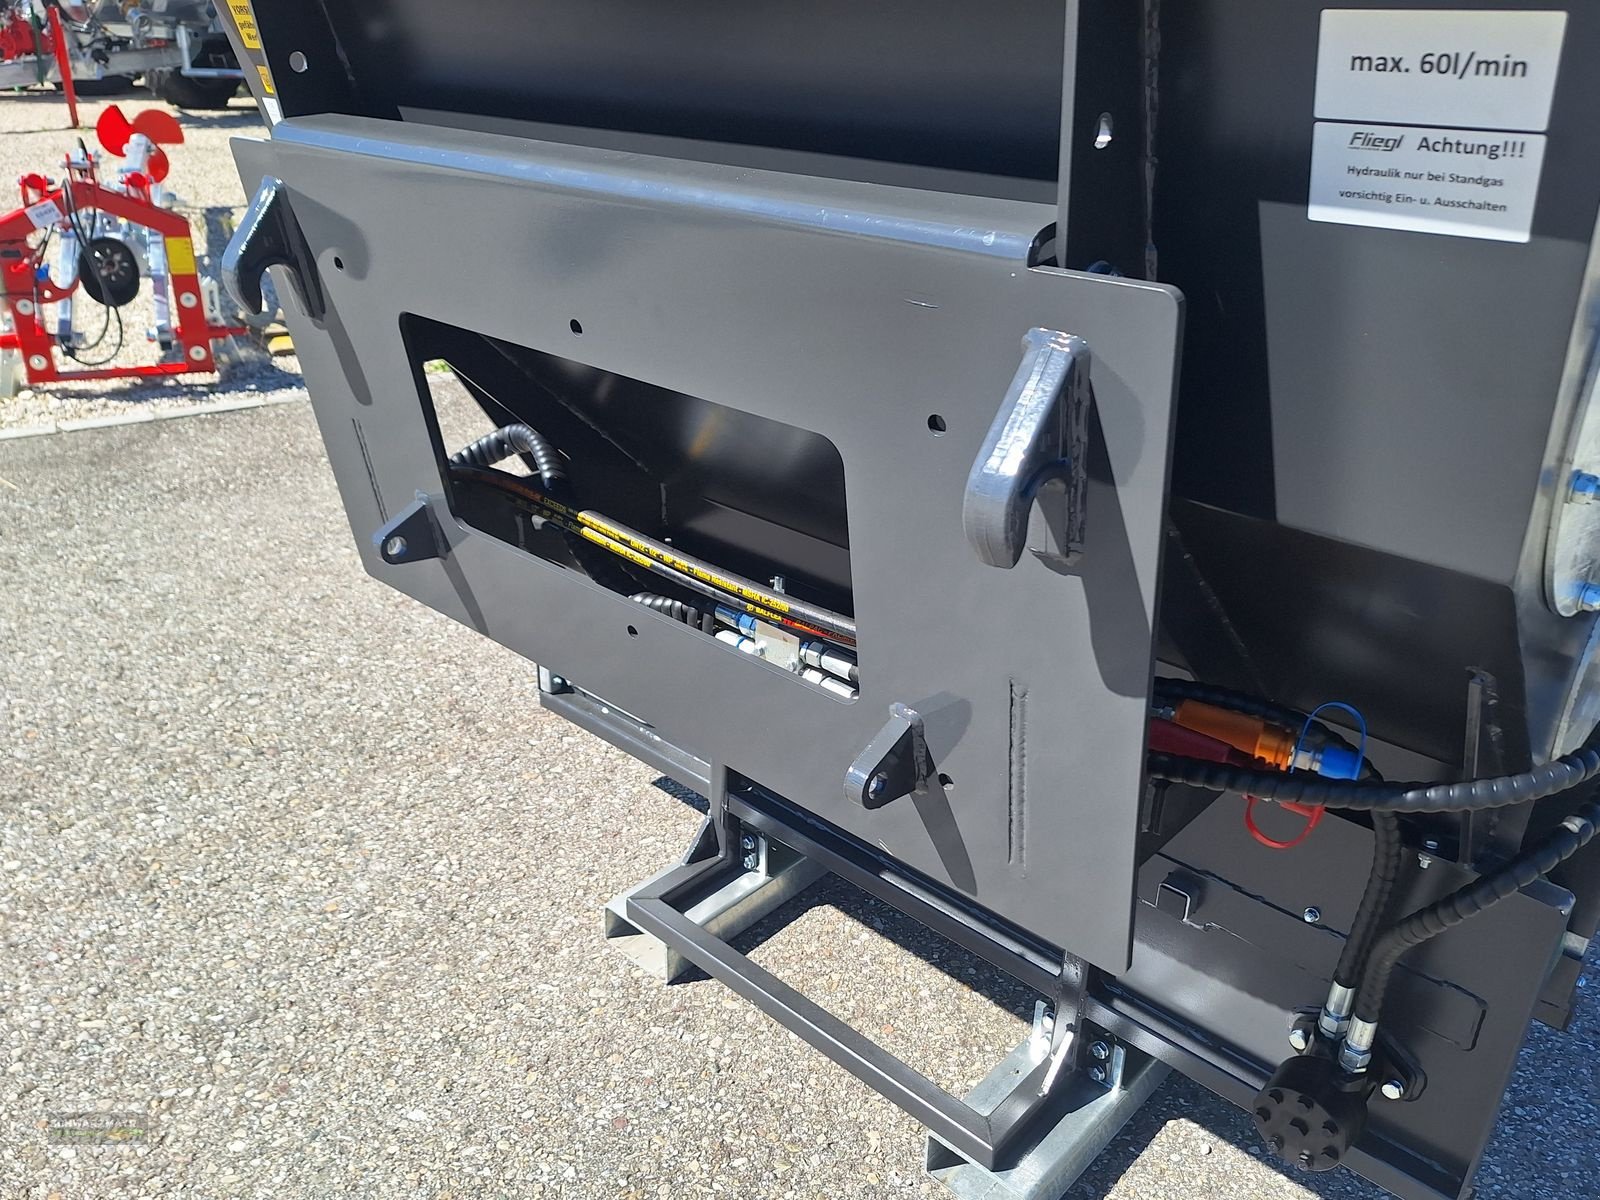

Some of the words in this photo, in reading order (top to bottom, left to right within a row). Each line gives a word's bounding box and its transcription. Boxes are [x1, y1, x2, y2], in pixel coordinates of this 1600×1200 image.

[1350, 54, 1410, 74] max.
[1420, 51, 1528, 80] 60l/min
[1348, 131, 1404, 152] Fliegl
[1417, 136, 1525, 160] Achtung!!!
[1347, 165, 1400, 178] Hydraulik
[1404, 170, 1423, 181] nur
[1427, 171, 1446, 183] bei
[1449, 173, 1504, 188] Standgas
[1339, 190, 1392, 204] vorsichtig
[1395, 193, 1417, 203] Ein-
[1434, 197, 1507, 213] Ausschalten
